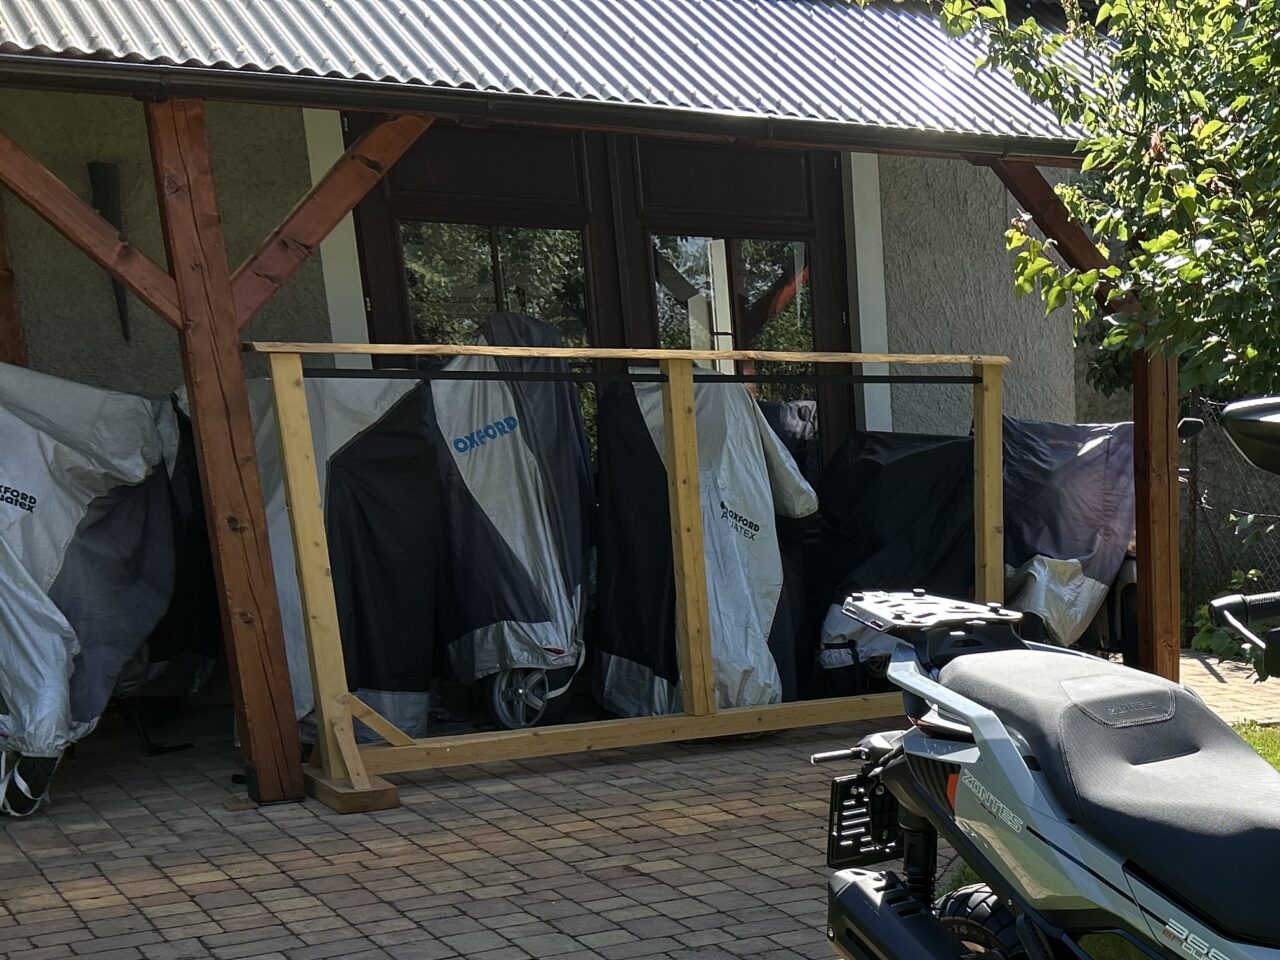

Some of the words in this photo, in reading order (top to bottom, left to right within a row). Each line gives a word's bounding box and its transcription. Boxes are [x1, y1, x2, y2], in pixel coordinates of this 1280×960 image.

[453, 415, 518, 453] OXFORD
[721, 511, 757, 541] AUATEX
[728, 509, 760, 532] OXFORD
[961, 768, 1024, 833] ZONTES
